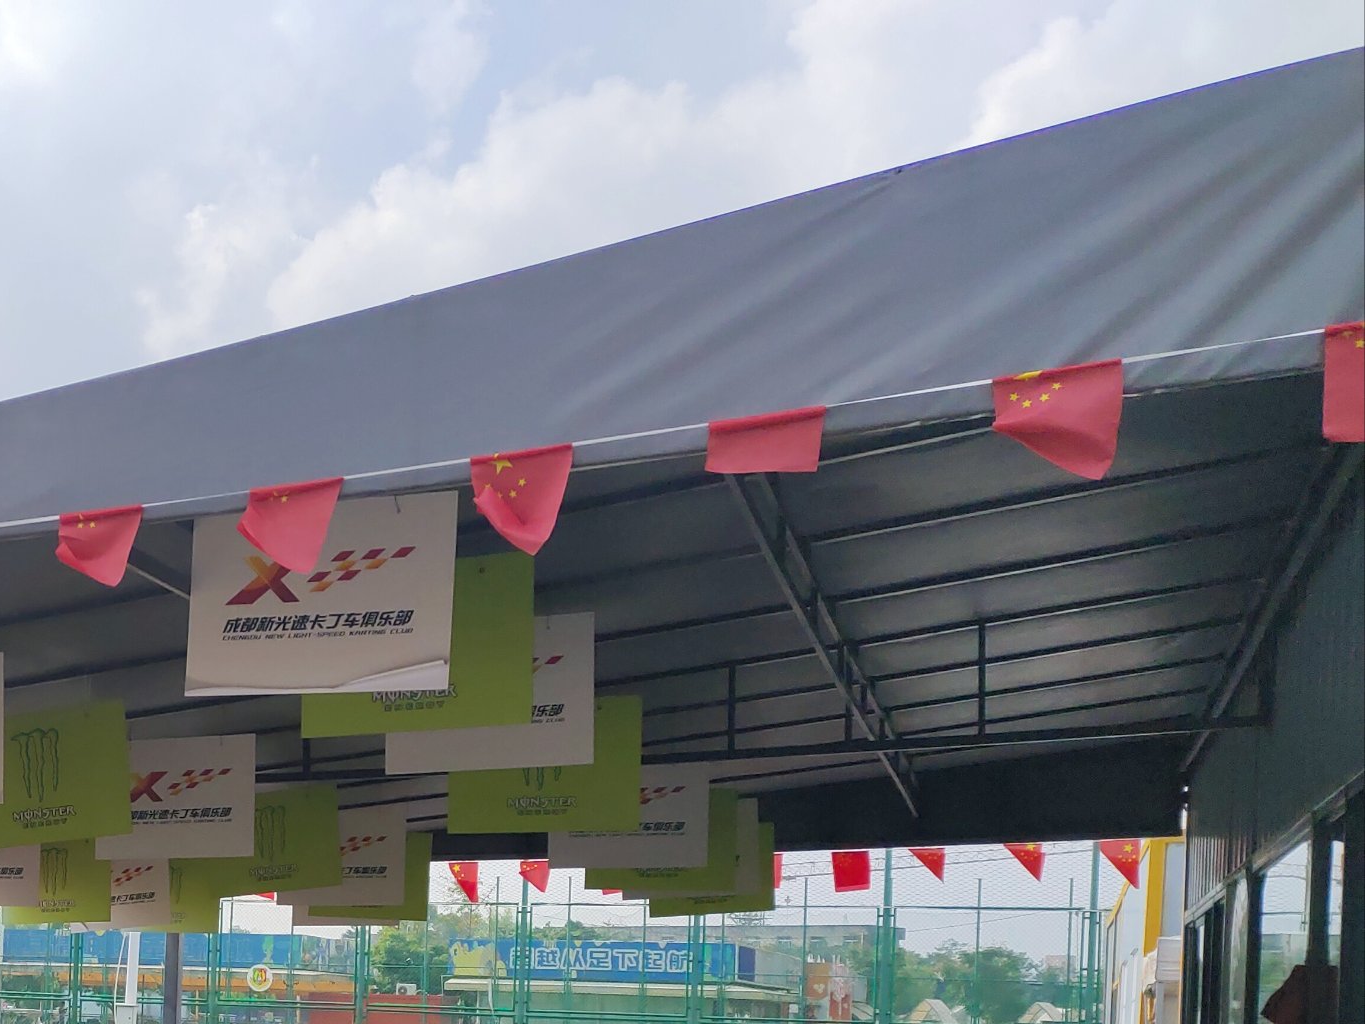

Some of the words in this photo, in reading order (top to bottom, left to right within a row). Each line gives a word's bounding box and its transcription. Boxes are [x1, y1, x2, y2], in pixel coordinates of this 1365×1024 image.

[223, 609, 414, 634] 成都新光速卡丁车俱乐部
[349, 628, 386, 636] KARTING
[506, 796, 577, 810] MONSTER
[12, 804, 77, 822] MONSTER
